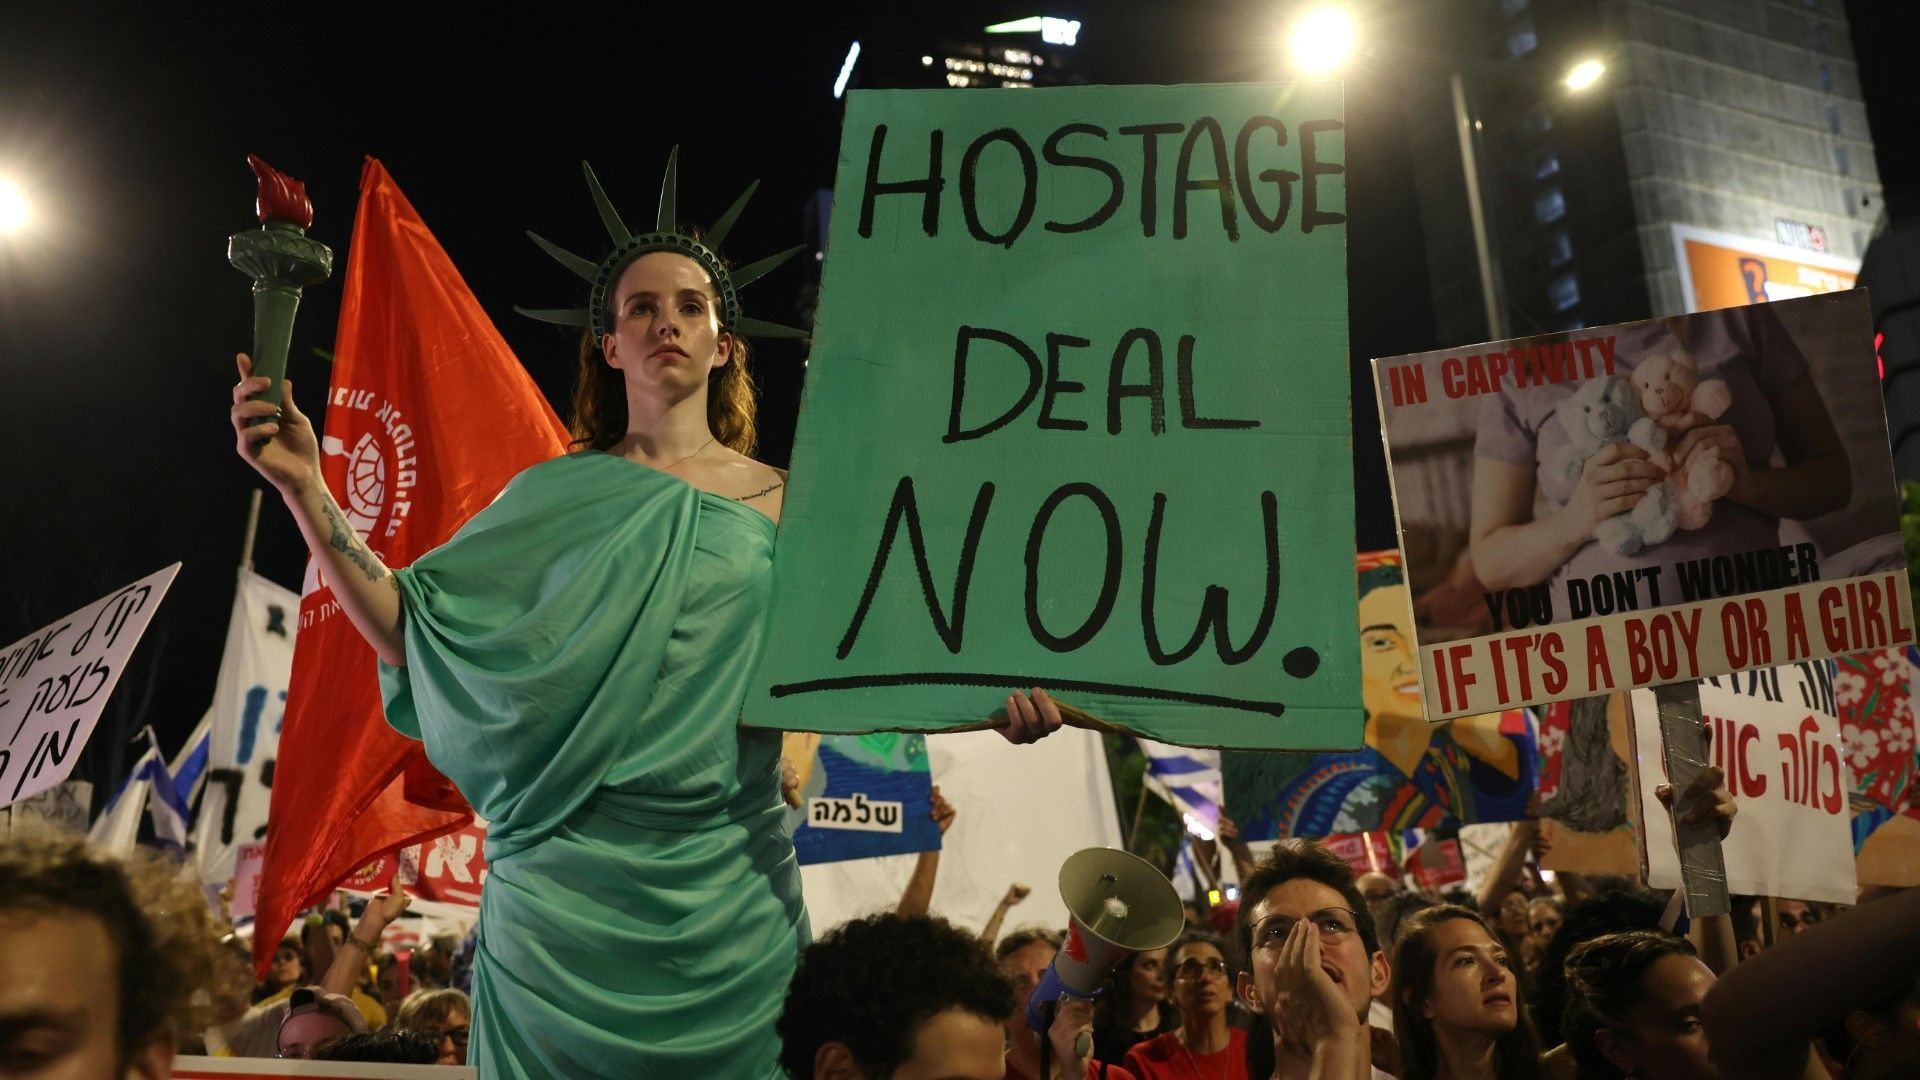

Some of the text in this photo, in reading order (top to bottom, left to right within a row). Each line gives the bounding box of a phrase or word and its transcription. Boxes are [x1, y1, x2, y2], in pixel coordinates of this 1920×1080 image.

[858, 115, 1345, 249] HOSTAGE
[942, 325, 1260, 444] DEAL
[1388, 336, 1616, 407] IN CAPTIVITY
[835, 475, 1320, 679] NOW.
[1483, 541, 1821, 631] YOU DON'T WONDER
[1433, 643, 1477, 713] IF
[1489, 632, 1568, 705] IT'S
[1585, 624, 1615, 692] A
[1625, 608, 1702, 685] BOY
[1721, 598, 1773, 670] OR
[1785, 592, 1810, 660] A
[1819, 575, 1912, 651] GIRL
[814, 795, 897, 825] שלמה
[1777, 714, 1842, 815] כולה
